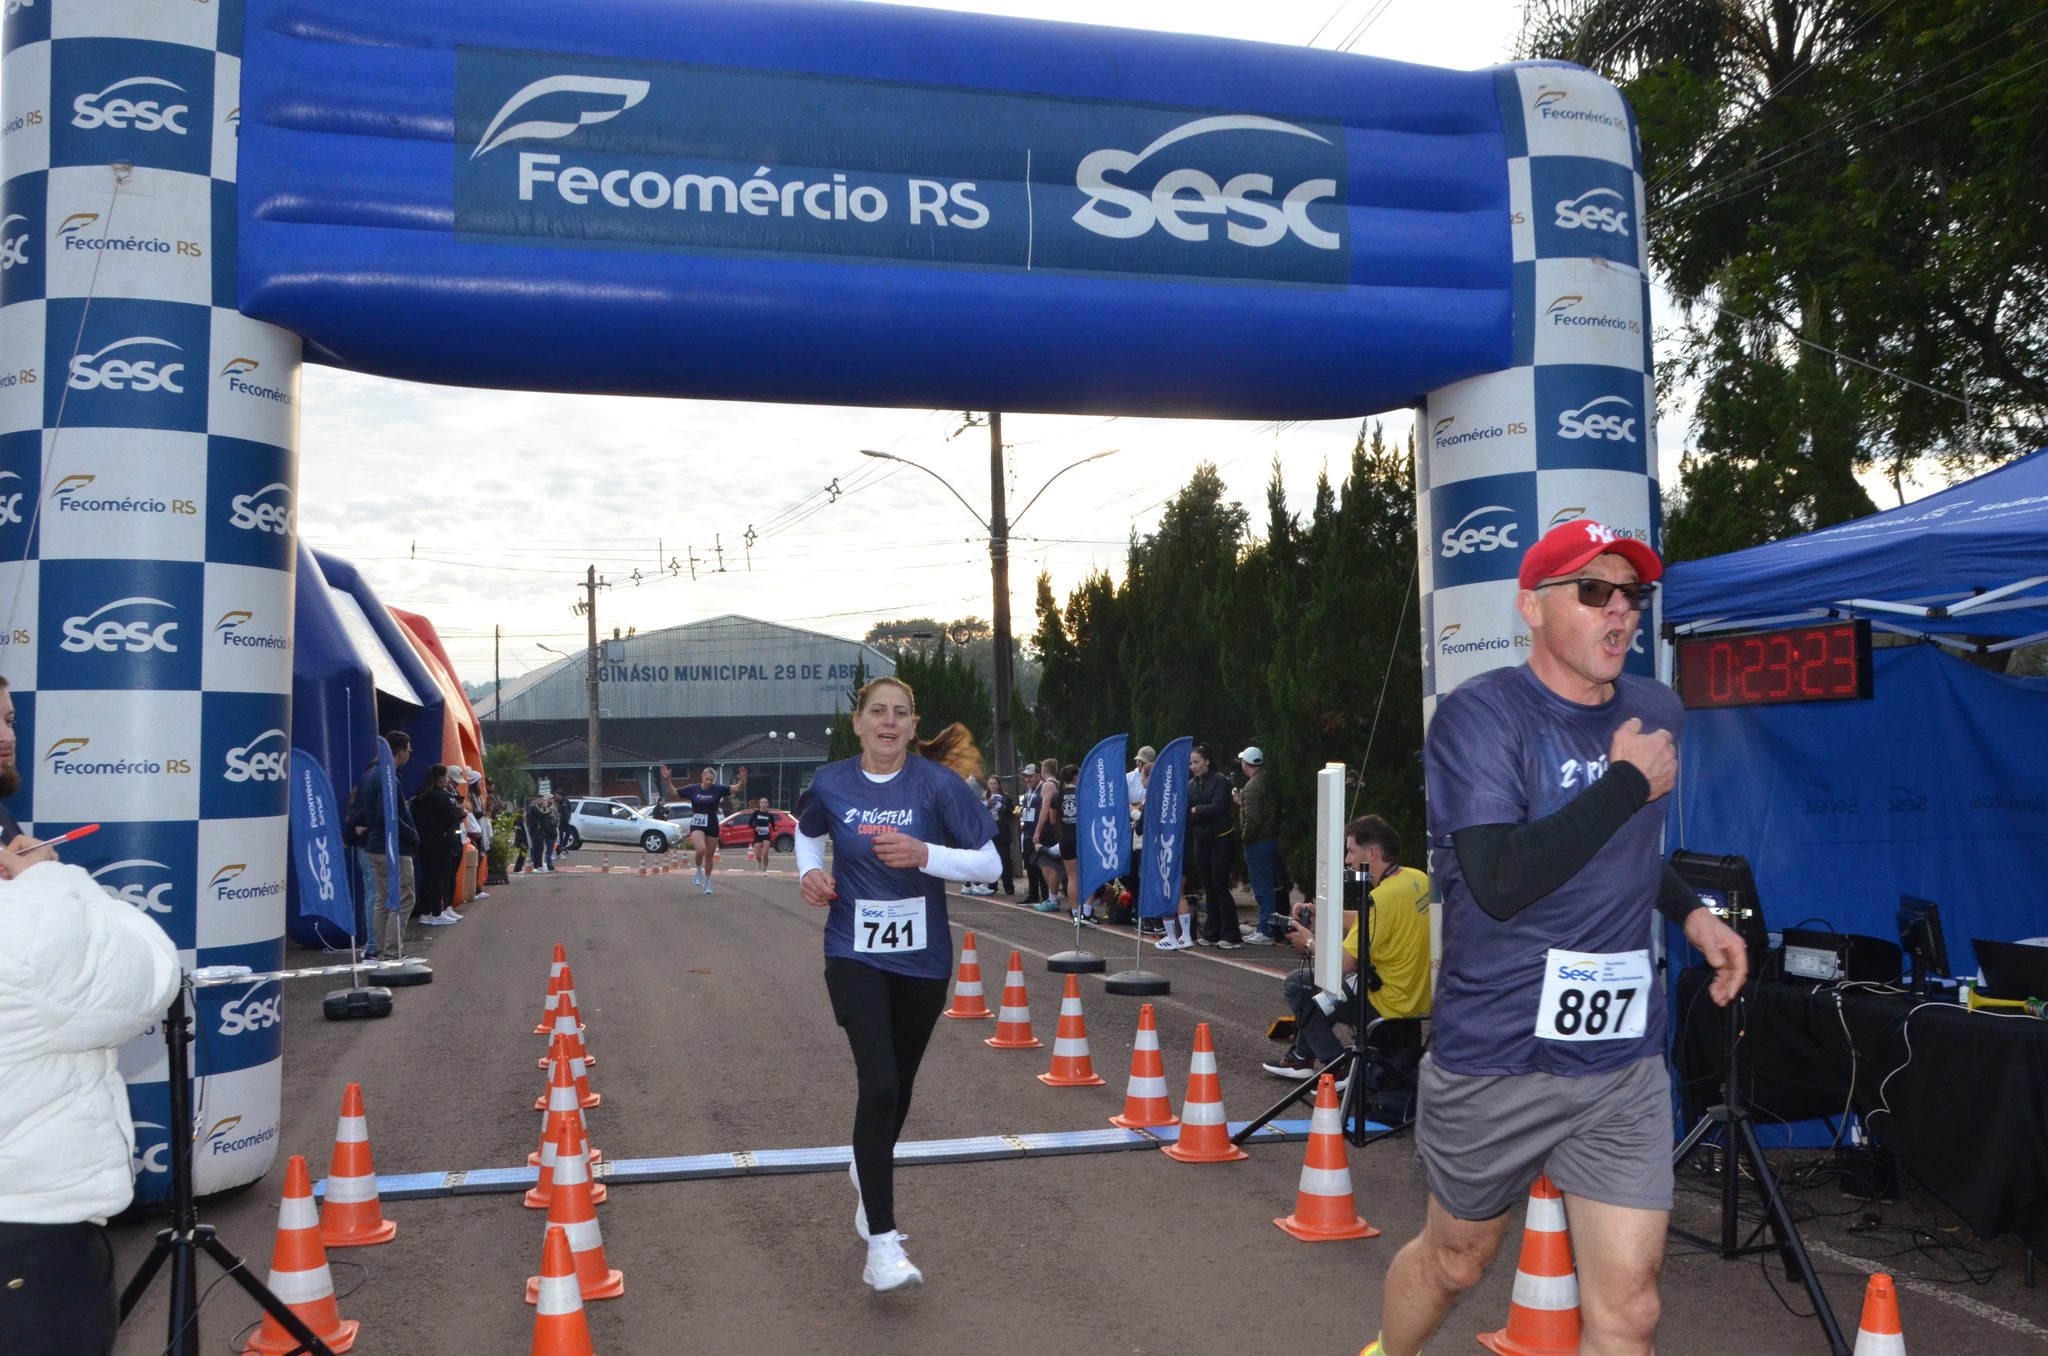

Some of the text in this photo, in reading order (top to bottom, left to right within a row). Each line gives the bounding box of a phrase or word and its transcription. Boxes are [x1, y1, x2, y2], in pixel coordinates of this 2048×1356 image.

[26, 110, 43, 127] RS
[71, 76, 188, 135] Sesc
[1542, 107, 1626, 132] Fecomércio RS
[519, 152, 991, 231] Fecomércio RS
[1072, 114, 1340, 250] Sesc
[1554, 187, 1629, 237] Sesc
[65, 236, 202, 258] Fecomércio RS
[1554, 313, 1640, 334] Fecomércio RS
[20, 368, 37, 384] RS
[67, 336, 184, 394] Sesc
[1556, 395, 1637, 443] Sesc
[1435, 422, 1528, 449] Fecomércio RS
[60, 496, 197, 515] Fecomércio RS
[1441, 505, 1518, 558] Sesc
[12, 629, 30, 645] RS
[60, 597, 178, 653] Sesc
[1442, 637, 1510, 655] Fecomércio
[599, 663, 875, 682] GINÁSIO MUNICIPAL 29 DE ABRL
[54, 759, 191, 776] Fecomércio RS
[1160, 764, 1173, 824] Fecomércio
[861, 808, 913, 825] RÚSTICA
[1092, 815, 1119, 871] Sesc
[308, 836, 335, 901] Sesc
[1157, 834, 1175, 899] Sesc
[217, 881, 280, 901] Fecomércio
[862, 905, 885, 918] Sesc
[863, 919, 914, 949] 741
[1558, 961, 1598, 982] Sesc
[1554, 988, 1637, 1036] 887
